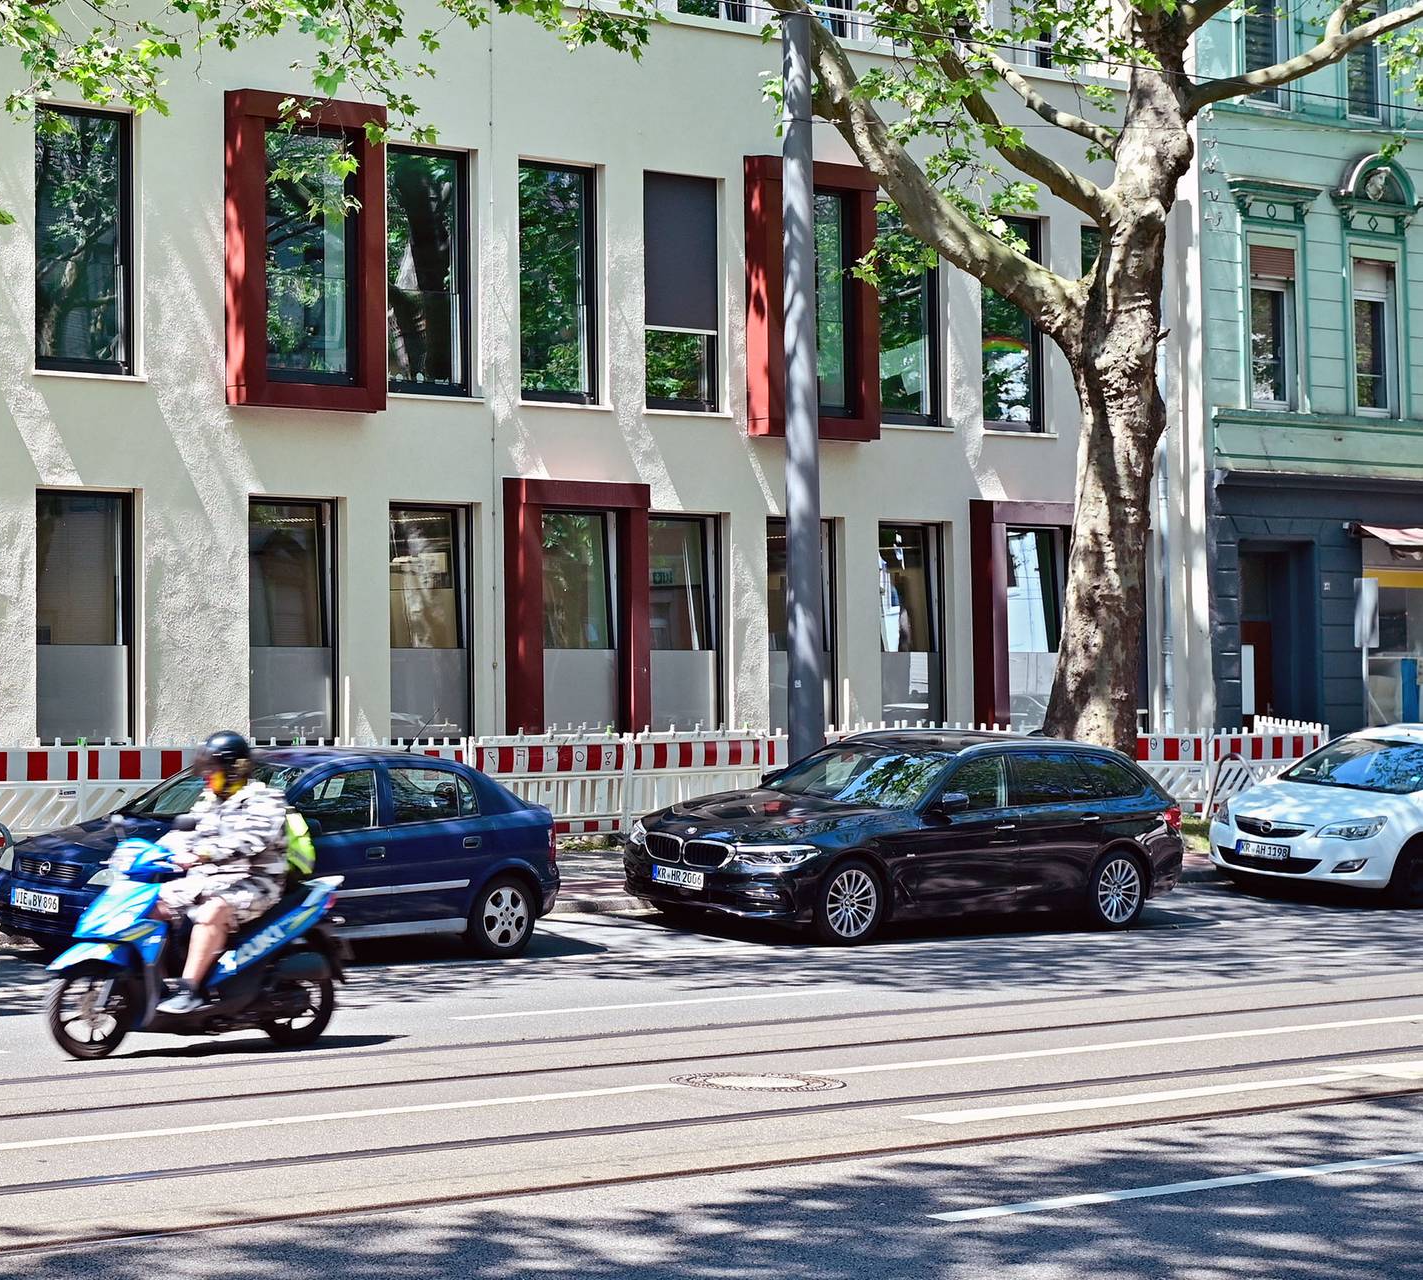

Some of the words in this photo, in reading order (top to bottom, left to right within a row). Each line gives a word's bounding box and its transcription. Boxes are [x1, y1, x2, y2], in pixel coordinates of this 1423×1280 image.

[1268, 846, 1287, 858] 1198
[682, 871, 702, 885] 2006
[33, 894, 42, 907] BY
[43, 896, 58, 910] 896
